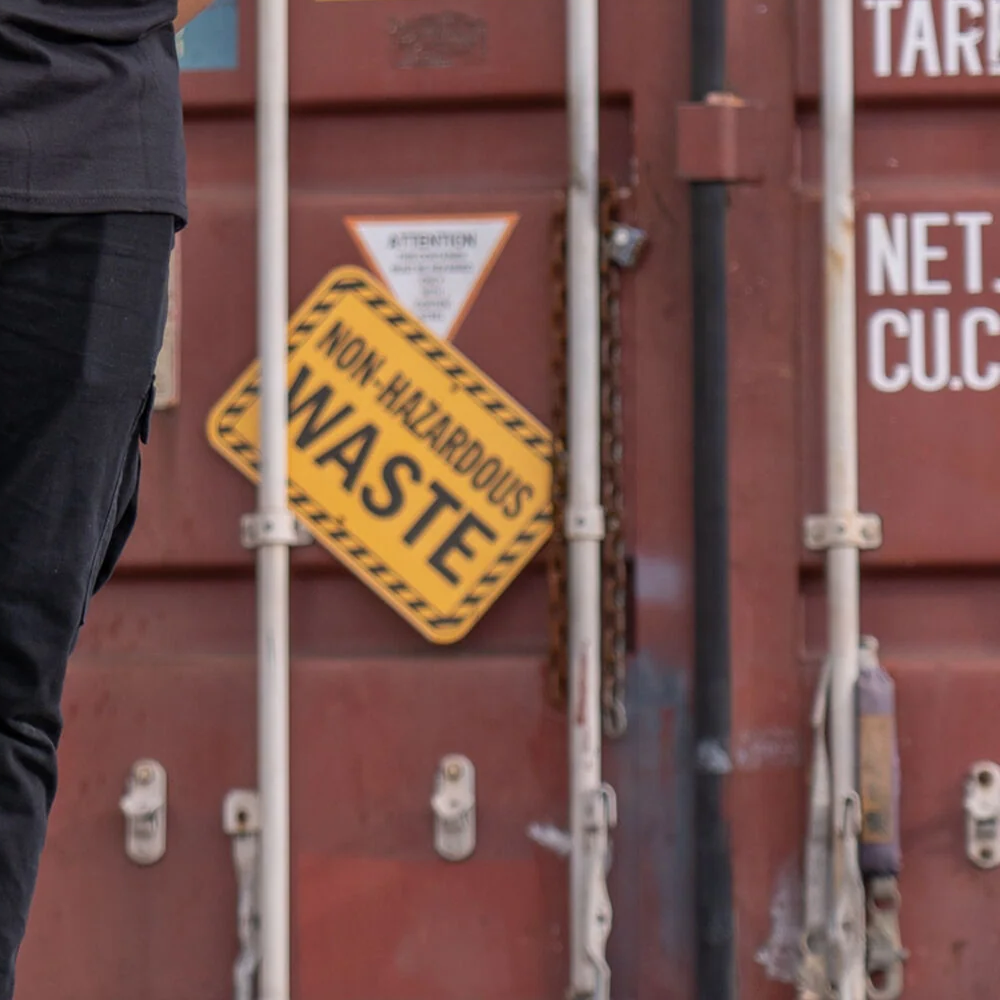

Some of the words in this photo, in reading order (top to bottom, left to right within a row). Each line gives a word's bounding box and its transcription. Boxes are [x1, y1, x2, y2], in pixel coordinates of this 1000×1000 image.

[387, 232, 478, 249] ATTENTION
[288, 365, 497, 586] WASTE
[317, 320, 534, 519] NON-HAZARDOUS
